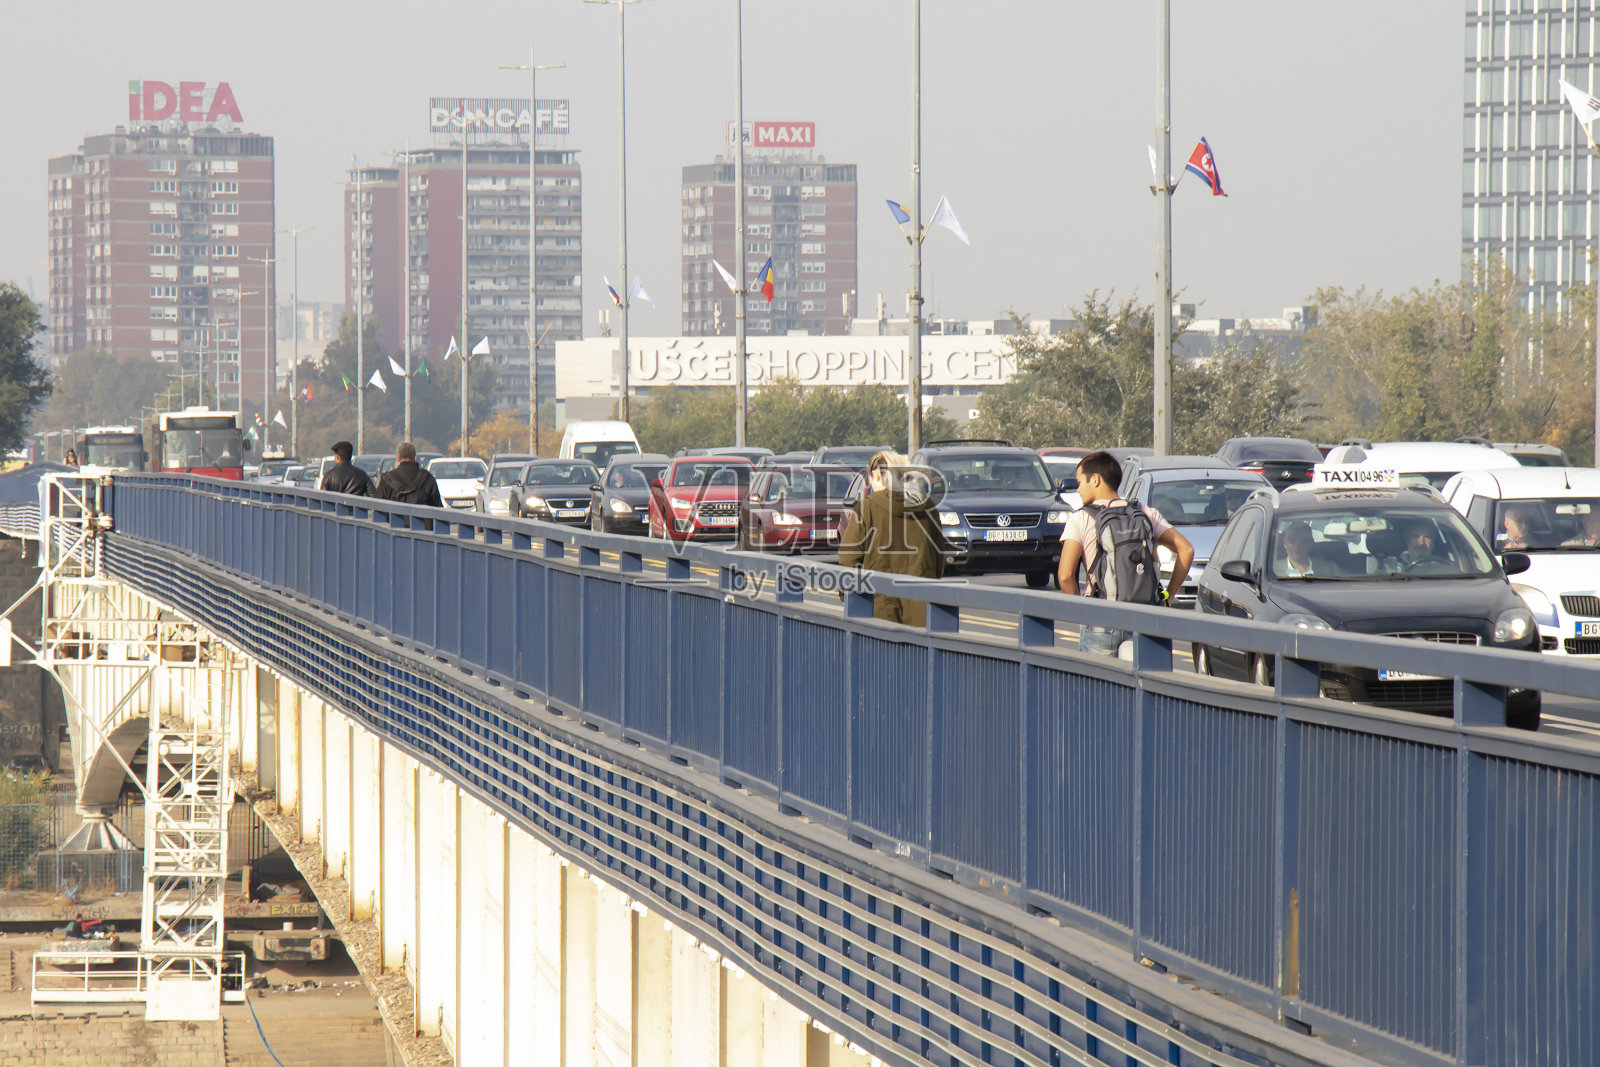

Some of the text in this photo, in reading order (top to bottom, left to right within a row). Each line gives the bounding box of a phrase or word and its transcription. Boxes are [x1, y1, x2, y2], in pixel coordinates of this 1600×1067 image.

[432, 104, 569, 128] DONCAFÉ
[758, 126, 811, 143] MAXI
[632, 339, 732, 381] UŠĆE
[946, 349, 1018, 380] CEN
[1321, 471, 1384, 482] TAXI 0496
[1584, 624, 1598, 635] BG
